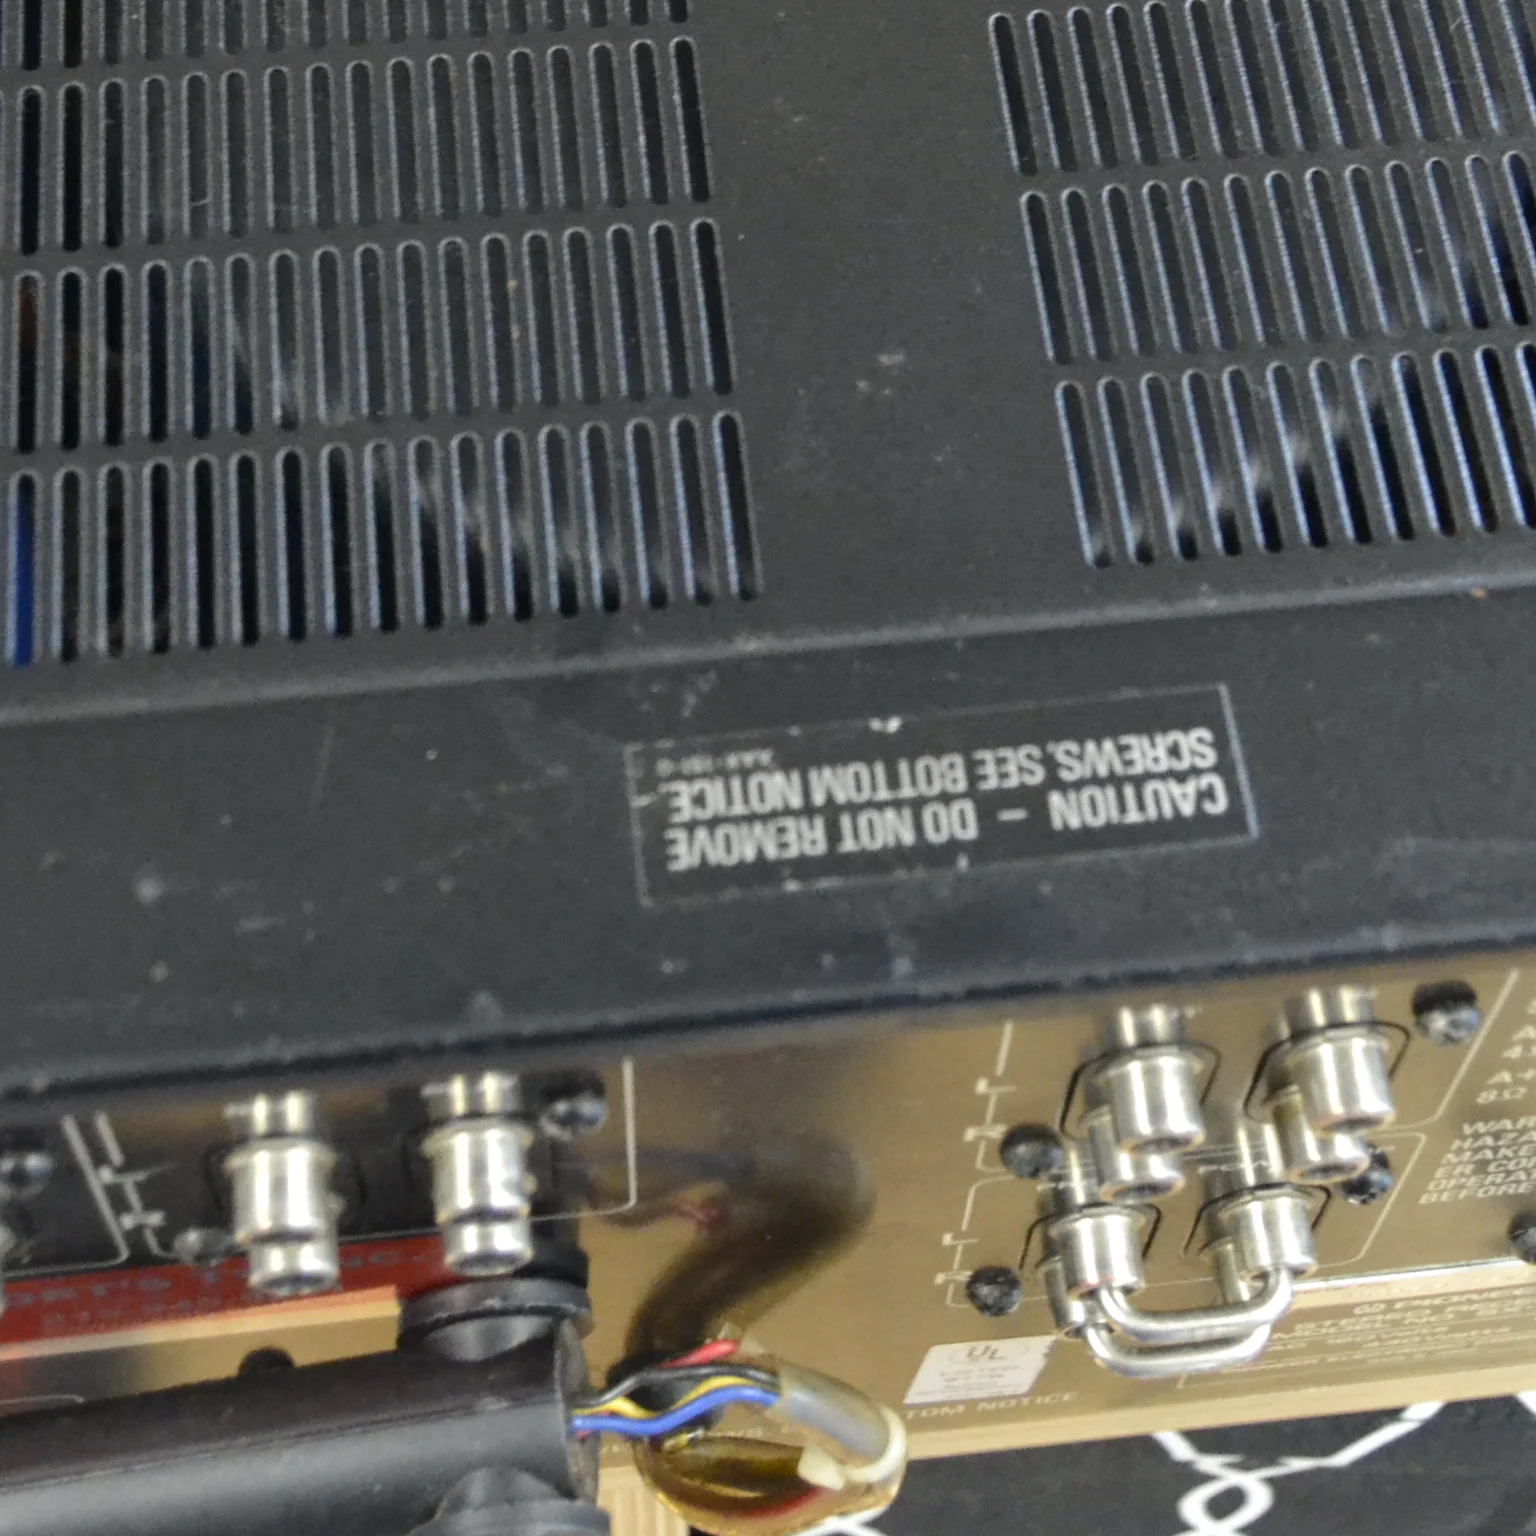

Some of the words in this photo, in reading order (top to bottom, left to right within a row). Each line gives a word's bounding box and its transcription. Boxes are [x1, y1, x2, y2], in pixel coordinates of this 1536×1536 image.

[971, 744, 1046, 792] SEE
[1045, 726, 1219, 783] SCREWS.
[807, 752, 969, 808] BOTTOM
[1046, 771, 1230, 832] CAUTION
[663, 814, 828, 873] REMOVE
[836, 804, 916, 854] NOT
[921, 797, 980, 845] DO
[1433, 1163, 1477, 1180] ER
[975, 1391, 1080, 1412] NOTICE
